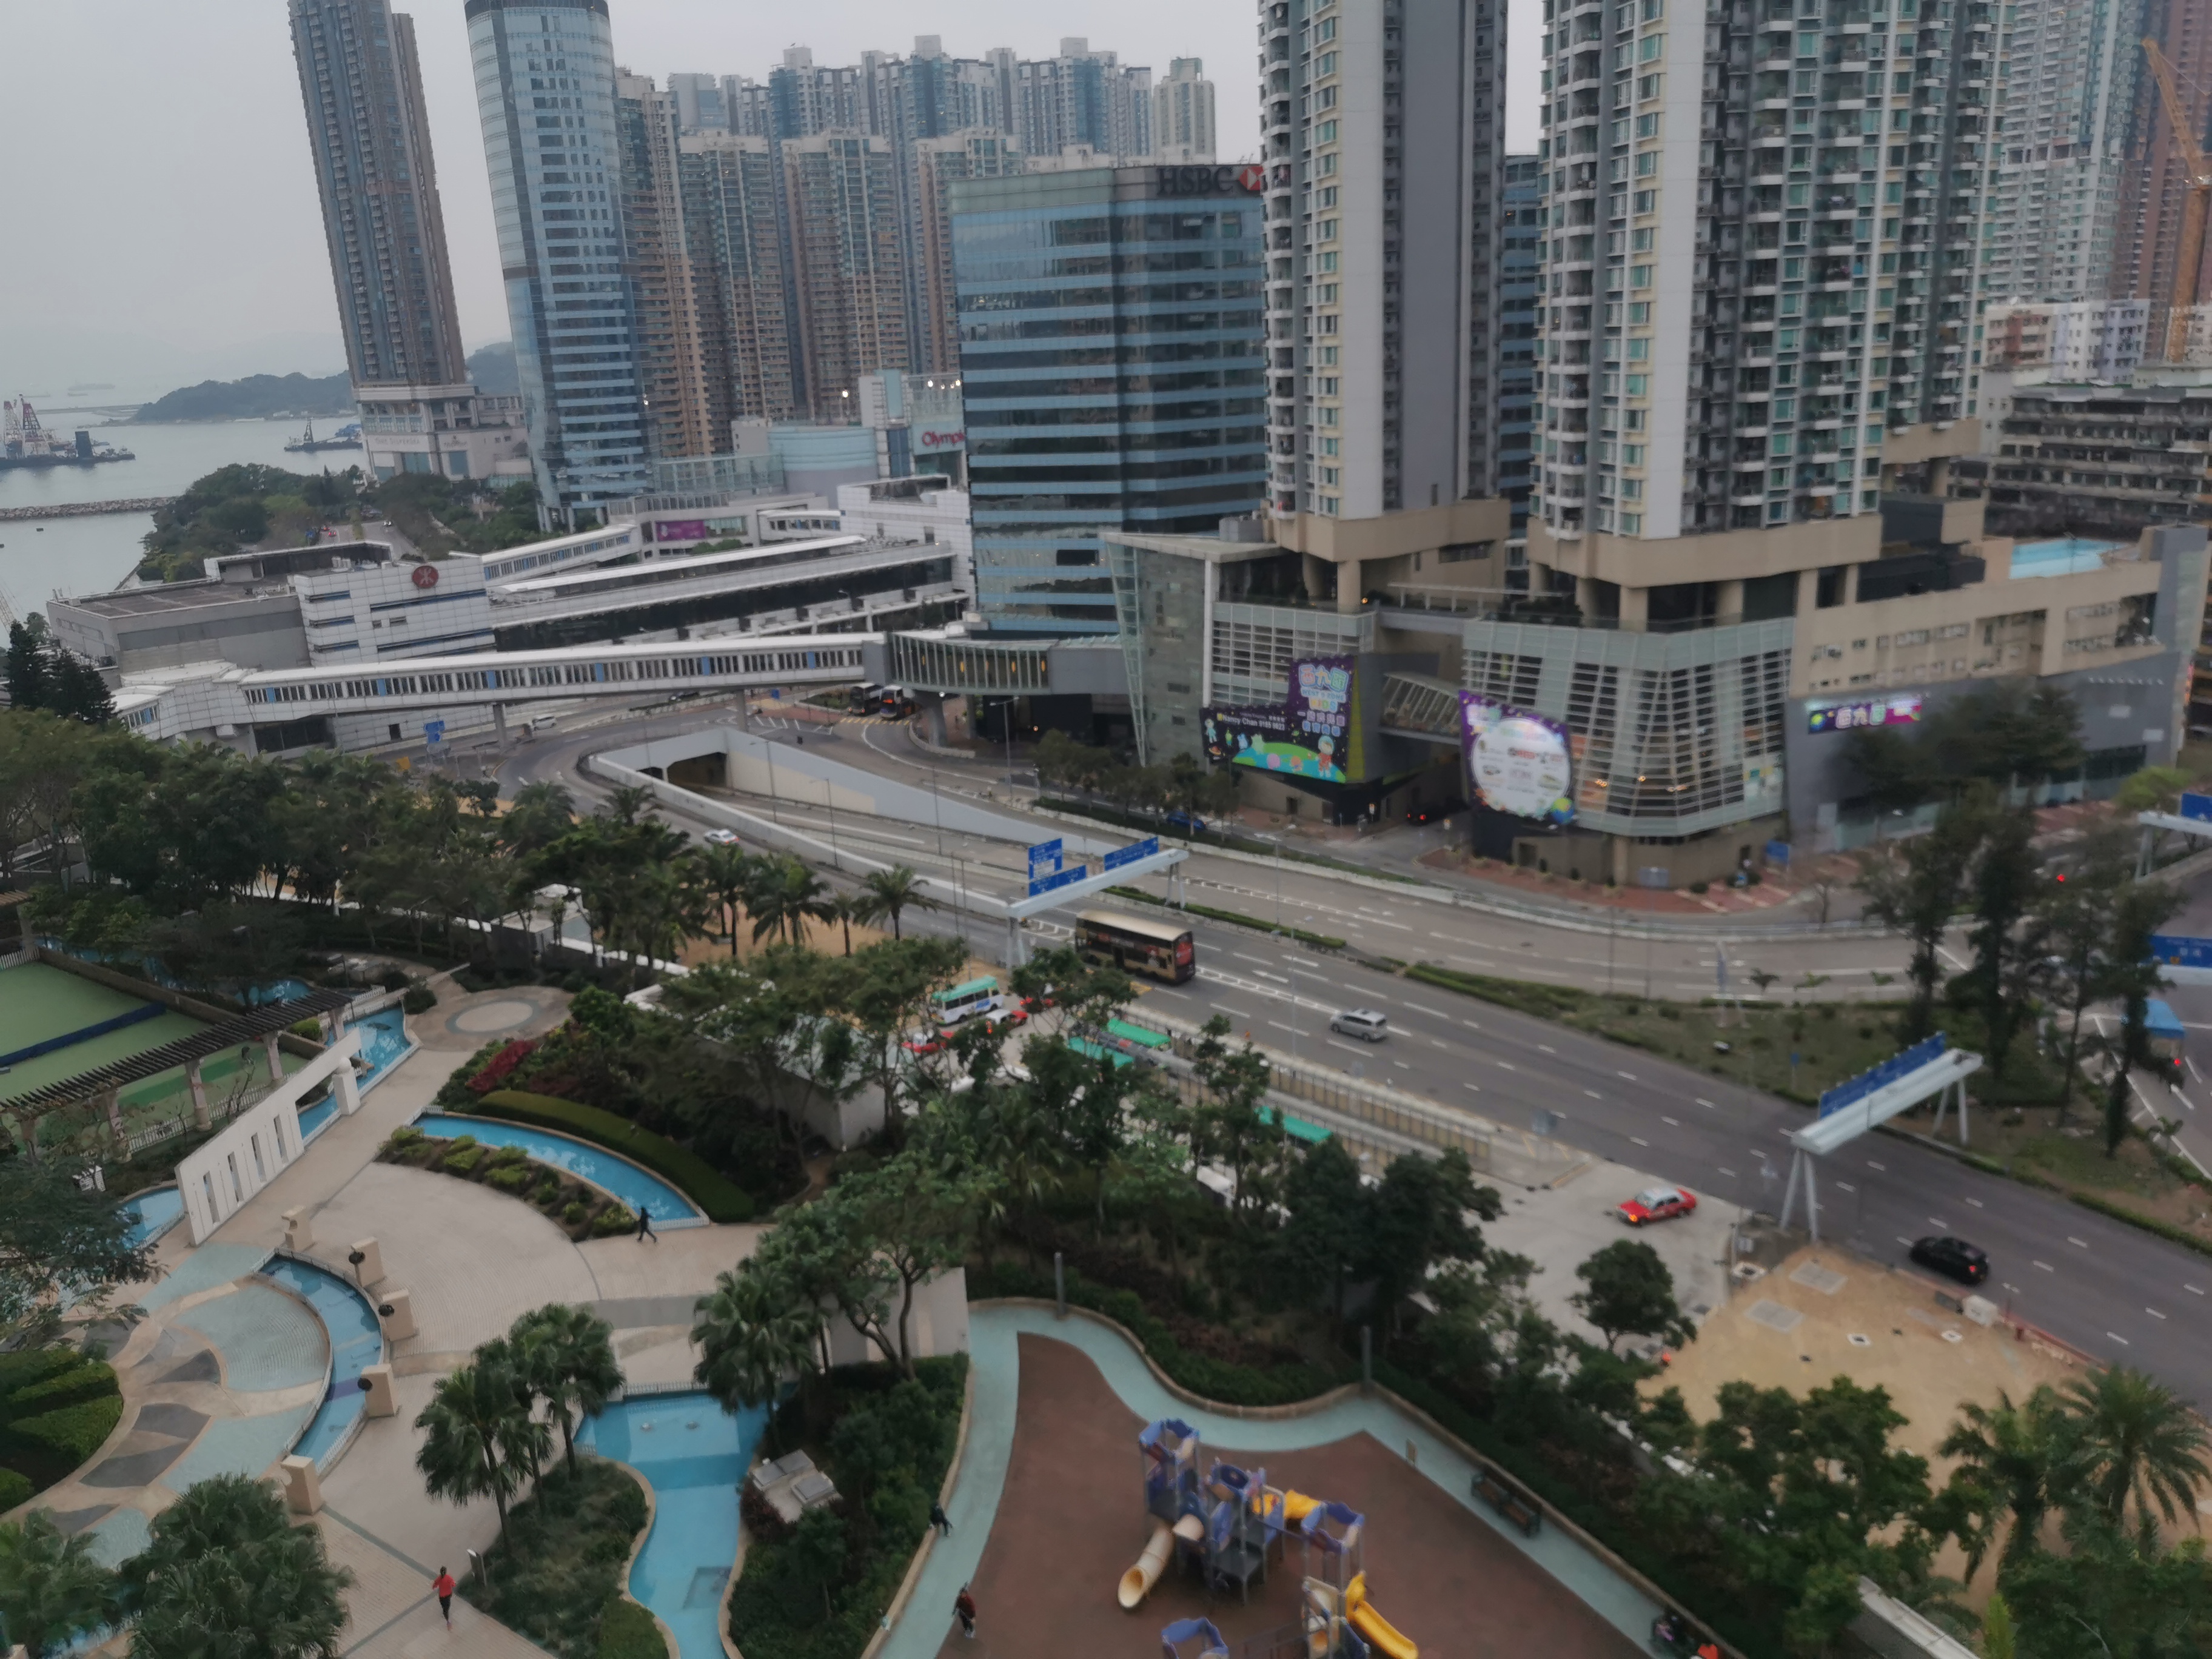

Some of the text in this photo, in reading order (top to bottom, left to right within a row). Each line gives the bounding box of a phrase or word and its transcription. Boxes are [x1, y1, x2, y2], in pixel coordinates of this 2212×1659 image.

[1157, 167, 1233, 195] HSBC
[1222, 713, 1241, 725] Nancy
[1242, 717, 1258, 726] Chan
